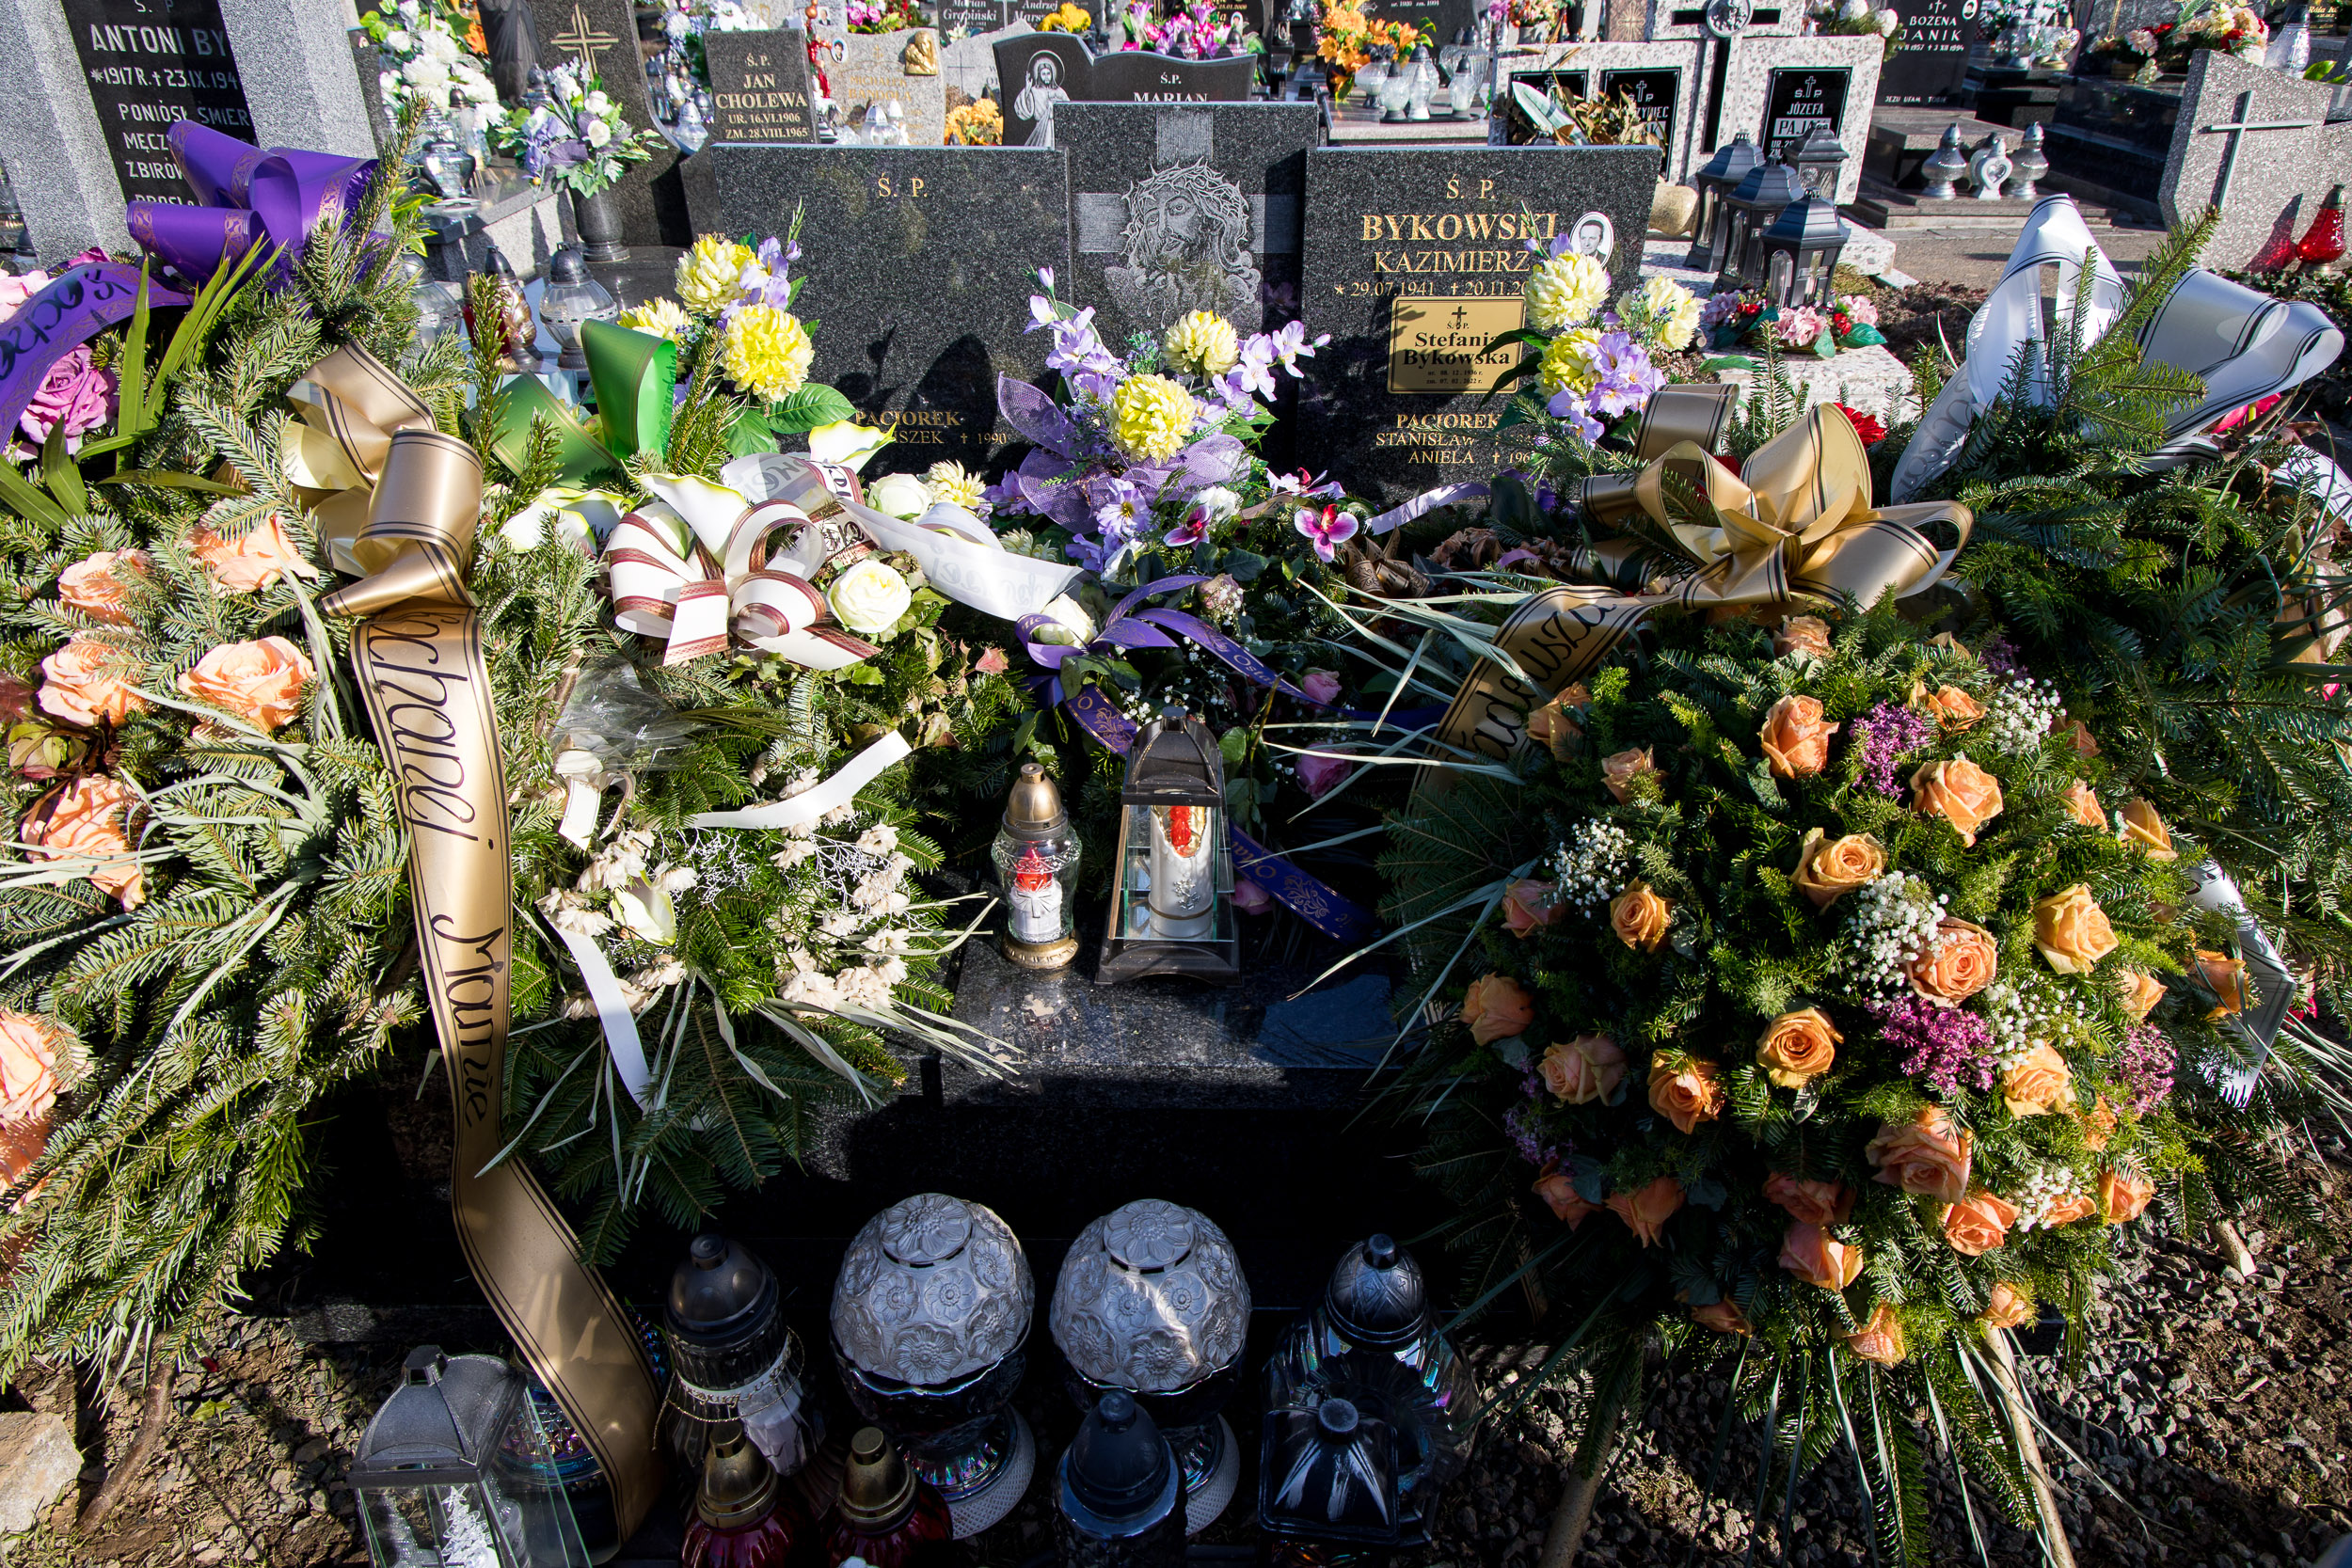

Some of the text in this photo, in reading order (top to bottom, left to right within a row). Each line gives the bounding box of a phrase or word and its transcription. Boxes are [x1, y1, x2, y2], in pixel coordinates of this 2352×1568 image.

[1021, 0, 1058, 11] Andrzej
[90, 24, 186, 55] ANTONI
[1898, 29, 1962, 41] JANIK
[759, 55, 771, 67] P.
[743, 73, 776, 88] JAN
[715, 92, 808, 109] CHOLEWA
[1786, 102, 1824, 115] JÓZEFA
[727, 112, 801, 124] UR. 16.VI.1906
[724, 129, 747, 139] ZM.
[878, 173, 929, 198] Ś. P.
[1446, 174, 1496, 199] Ś. P.
[1359, 213, 1560, 241] BYKOWSKI
[1373, 250, 1531, 273] KAZIMIERZ
[1350, 280, 1435, 297] 29.07.1941
[1403, 349, 1510, 369] Bykowska
[854, 410, 962, 427] PACIOREK
[1396, 414, 1502, 429] PACIOREK
[977, 433, 1009, 445] 1990
[1407, 451, 1475, 464] ANIELA
[429, 913, 505, 1128] Mamie
